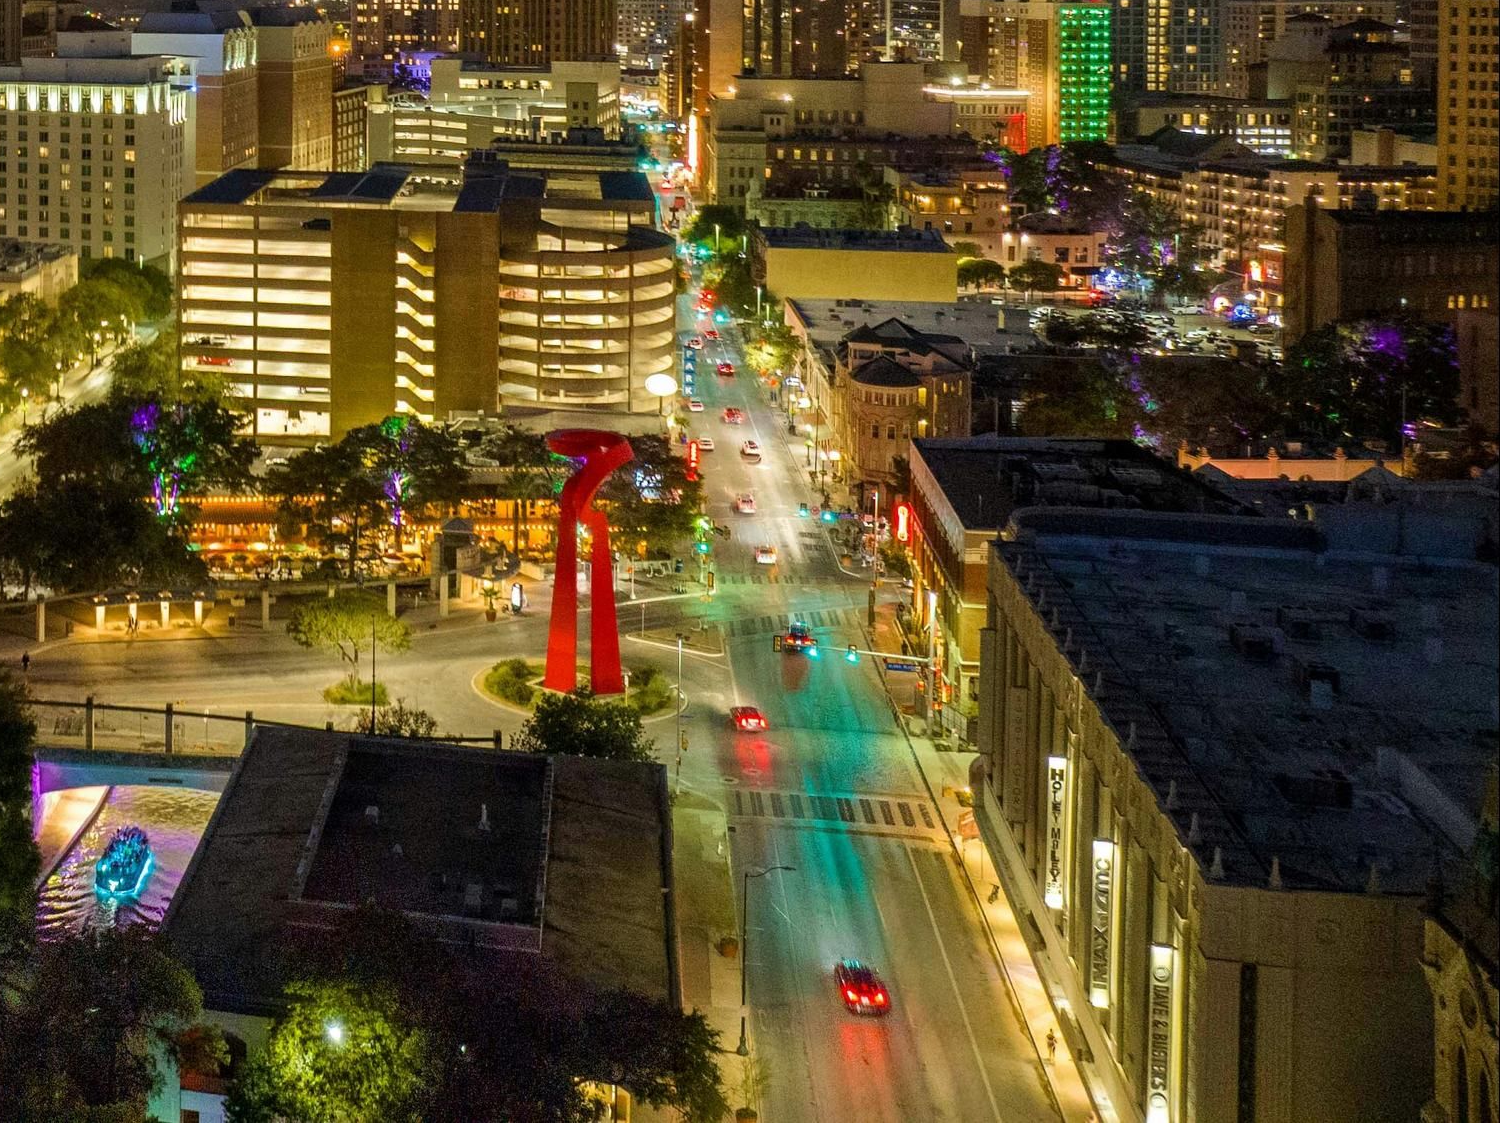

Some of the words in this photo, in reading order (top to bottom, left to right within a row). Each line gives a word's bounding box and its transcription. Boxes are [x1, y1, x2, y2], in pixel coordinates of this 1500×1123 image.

[685, 350, 694, 395] PARK
[1050, 768, 1064, 823] HOLEY
[1048, 828, 1062, 882] MOLEY
[1093, 926, 1109, 989] IMAX
[1152, 984, 1170, 1015] DAVE
